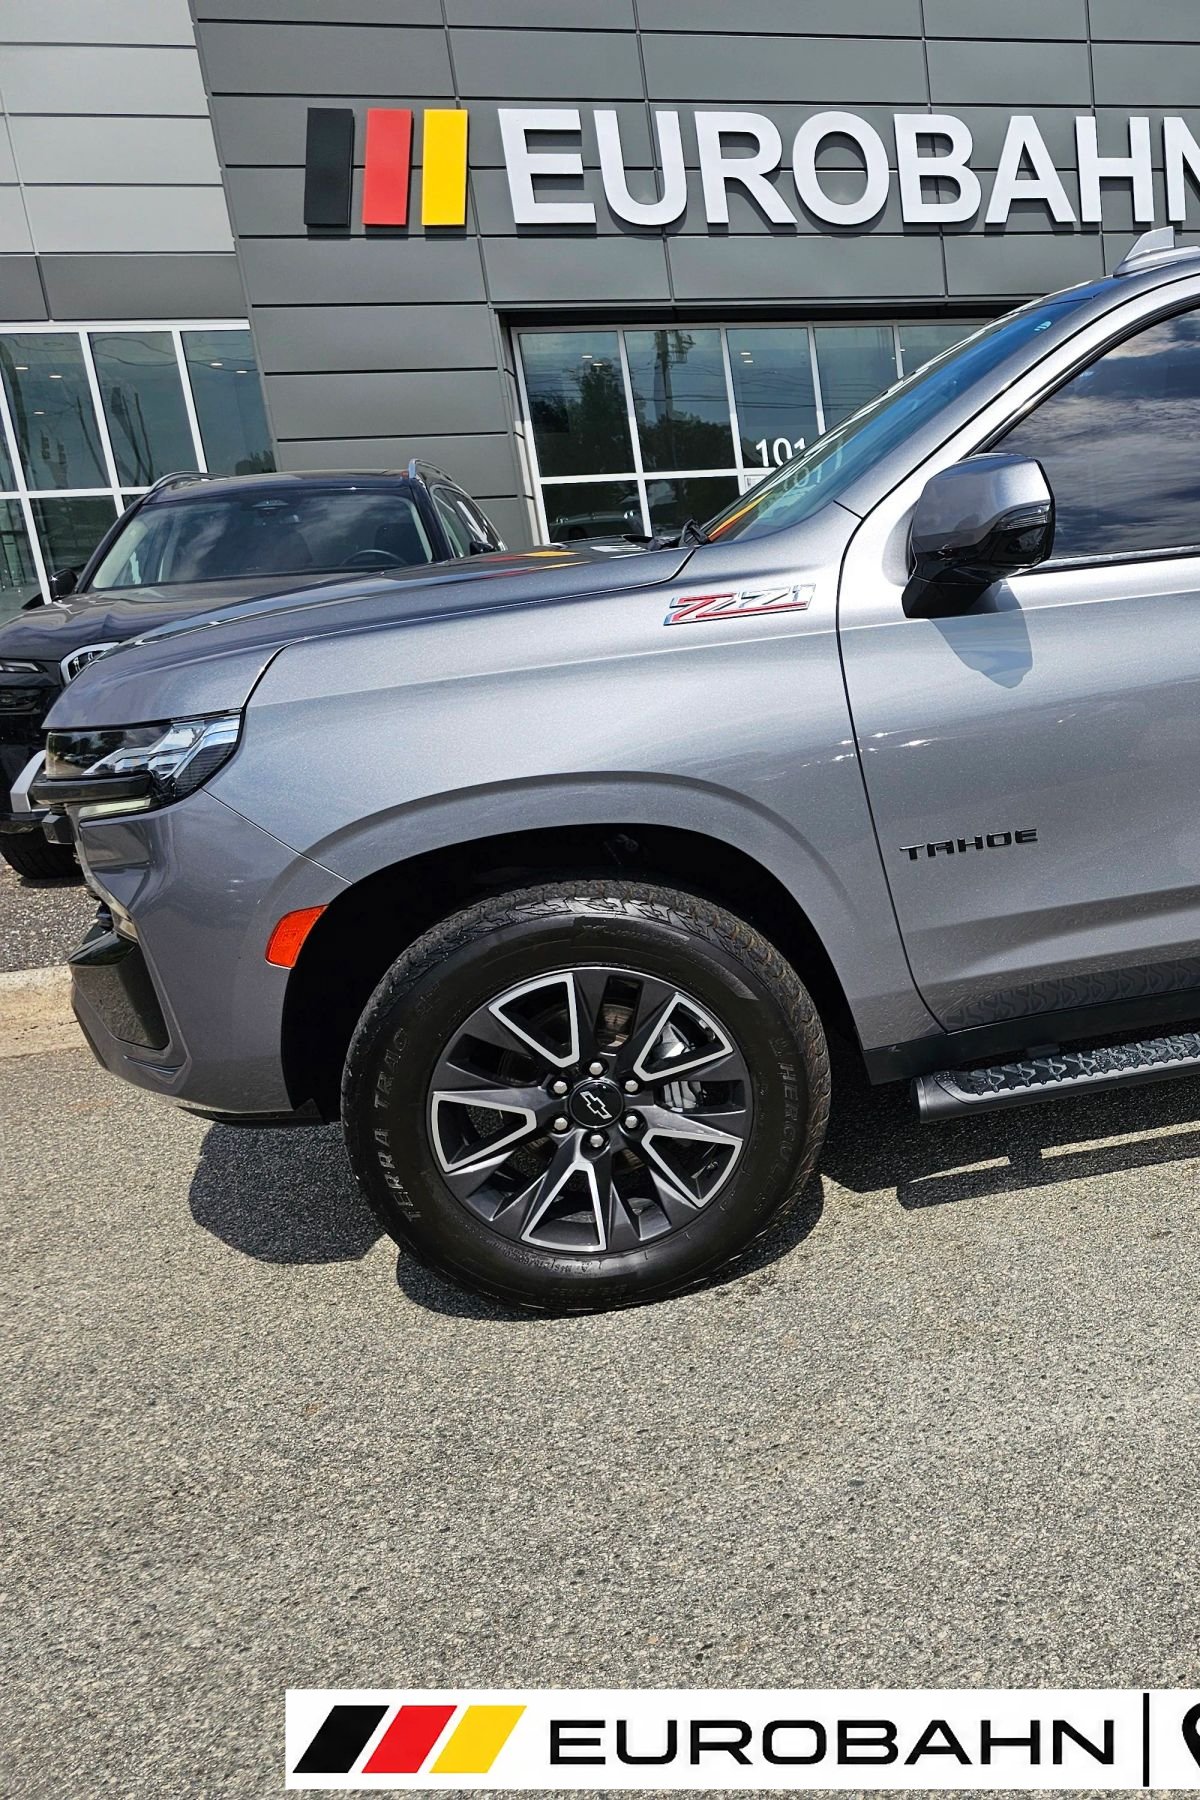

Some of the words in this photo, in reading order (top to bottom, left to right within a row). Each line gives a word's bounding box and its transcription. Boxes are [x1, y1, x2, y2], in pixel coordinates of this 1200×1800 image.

[663, 584, 816, 626] Z71
[900, 828, 1038, 861] TAHOE
[374, 1128, 422, 1223] TERRA
